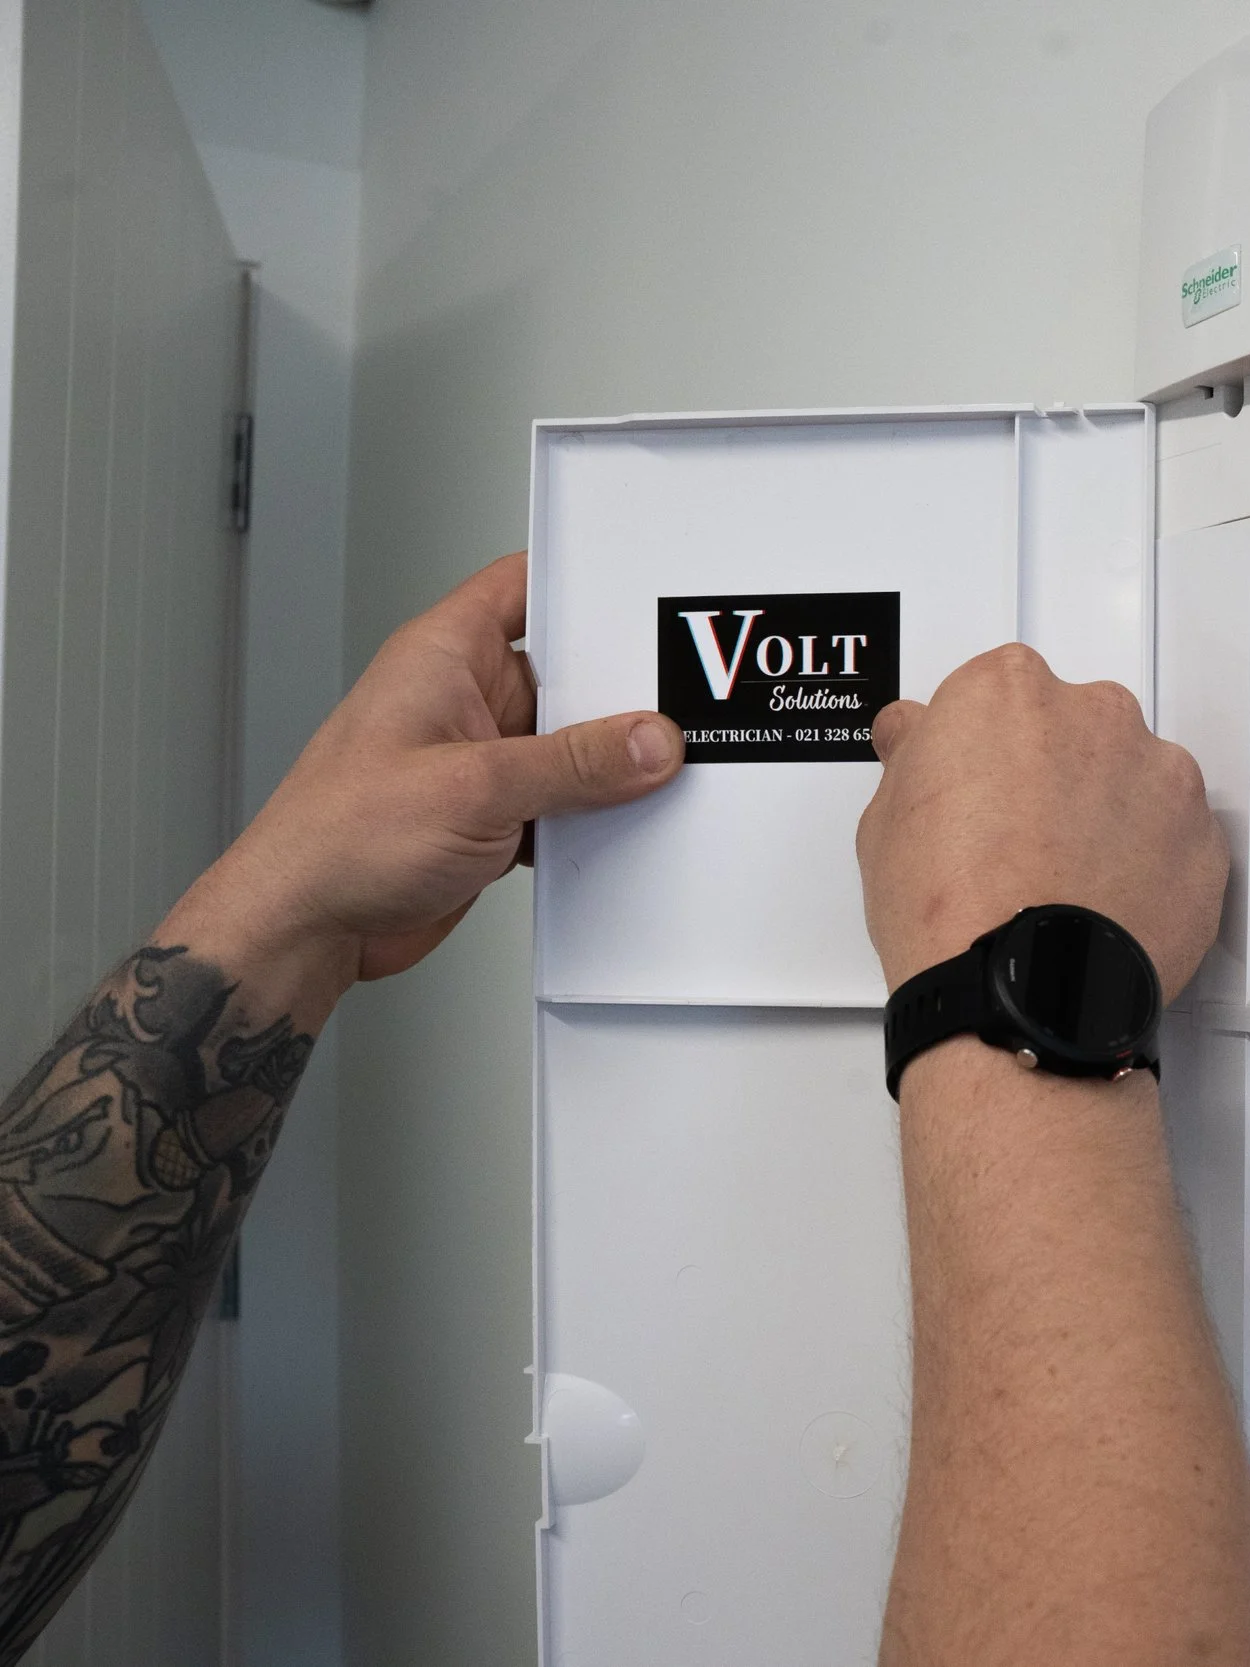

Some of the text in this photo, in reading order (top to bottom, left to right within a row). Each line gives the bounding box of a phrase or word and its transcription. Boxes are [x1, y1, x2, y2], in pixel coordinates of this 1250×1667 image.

[1181, 262, 1238, 304] Schneider
[1202, 278, 1237, 300] Electric
[677, 609, 869, 700] VOLT
[769, 685, 863, 712] Solutions
[683, 728, 784, 744] ELECTRICIAN
[795, 728, 820, 742] 021
[824, 728, 850, 742] 328
